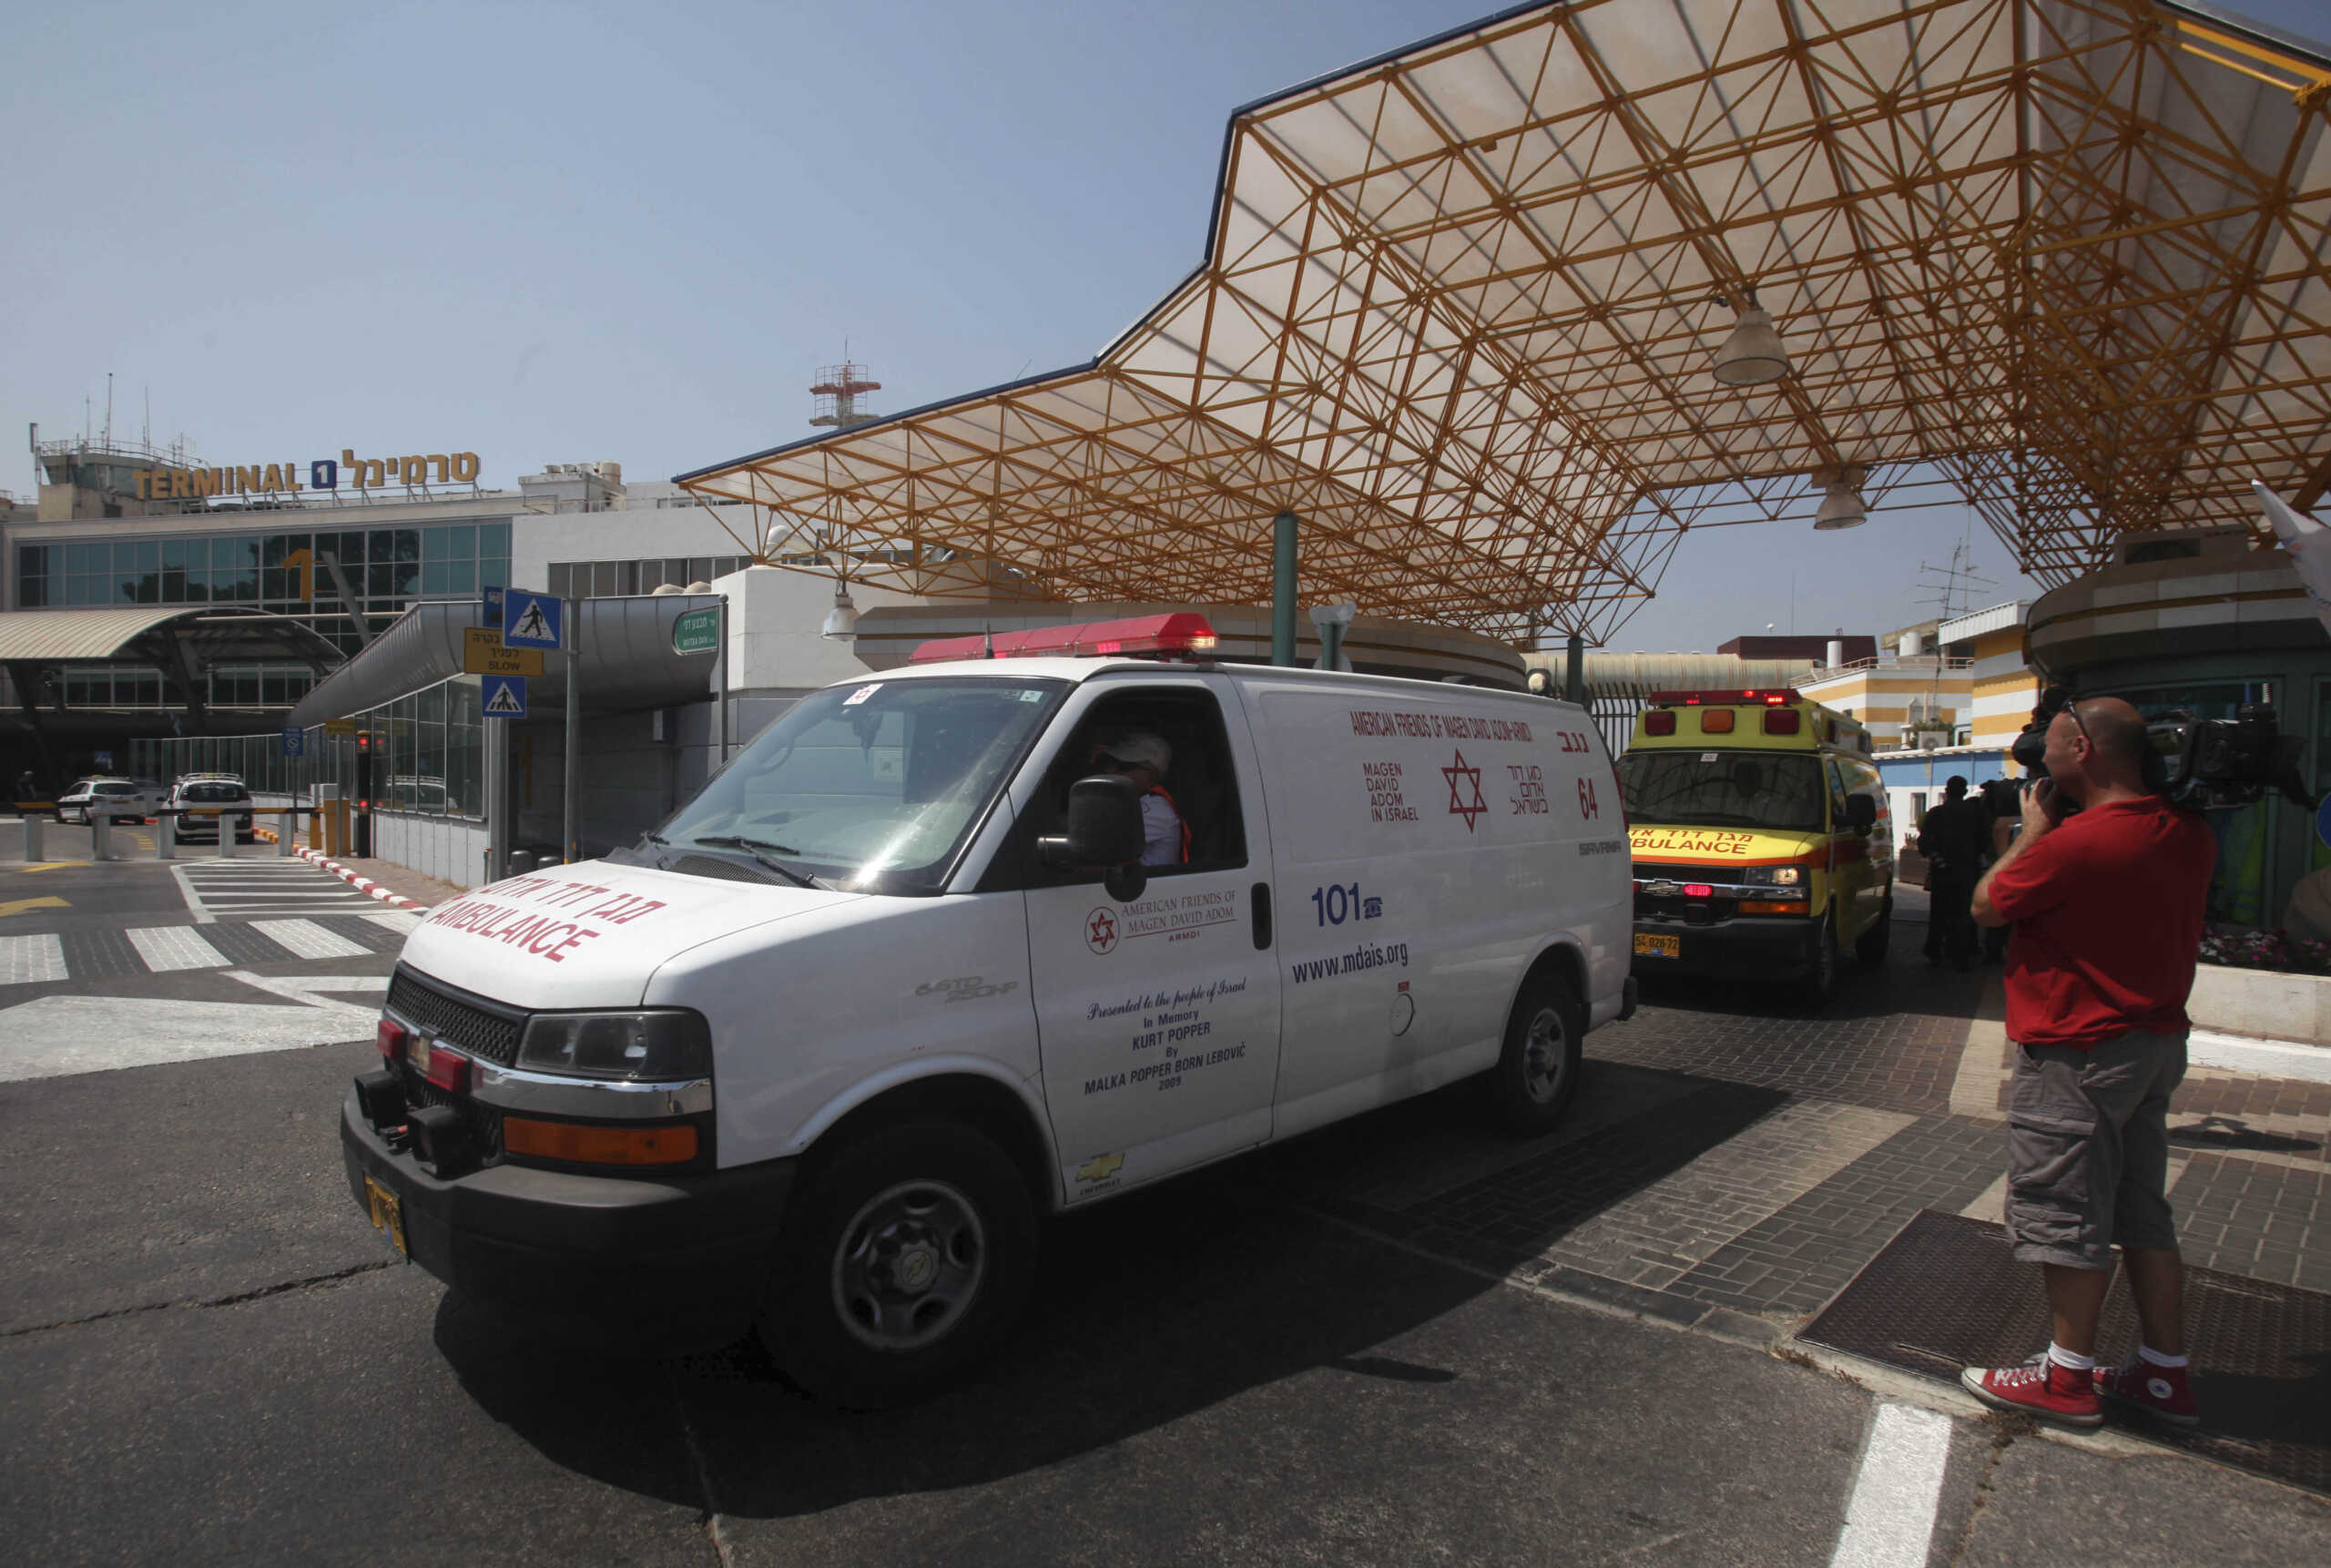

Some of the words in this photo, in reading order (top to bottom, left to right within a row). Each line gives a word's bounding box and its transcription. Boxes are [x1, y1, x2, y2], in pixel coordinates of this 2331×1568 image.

[341, 449, 480, 488] טרמינל
[131, 463, 303, 499] TERMINAL
[488, 661, 520, 671] SLOW
[1350, 710, 1397, 737] AMERICAN
[1394, 713, 1432, 738] FRIENDS
[1430, 715, 1443, 738] OF
[1441, 715, 1472, 739] MAGEN
[1468, 717, 1491, 740] DAVID
[1556, 731, 1590, 754] נגב
[1363, 762, 1402, 777] MAGEN
[1507, 765, 1523, 780] דוד
[1527, 765, 1542, 780] מגן
[1366, 778, 1400, 791] DAVID
[1520, 782, 1545, 798] אדום
[1370, 792, 1404, 807] ADOM
[1577, 777, 1599, 820] 64
[1371, 807, 1383, 822] IN
[1385, 807, 1420, 822] ISRAEL
[1631, 829, 1654, 837] אד
[1667, 830, 1705, 839] דוד
[1716, 832, 1754, 843] מגן
[1630, 838, 1749, 854] BULANCE
[535, 881, 612, 909] דוד
[1121, 897, 1177, 918] AMERICAN
[1182, 892, 1223, 910] FRIENDS
[1225, 890, 1237, 902] OF
[1312, 882, 1360, 927] 101
[575, 893, 668, 926] מגן
[1128, 916, 1166, 934] MAGEN
[1171, 911, 1203, 927] DAVID
[1206, 906, 1235, 921] ADOM
[425, 900, 602, 962] AMBULANCE
[1292, 942, 1409, 984] www.mdais.org
[1086, 994, 1143, 1021] Presented
[1143, 993, 1154, 1011] to
[1155, 990, 1171, 1008] the
[1173, 984, 1205, 1011] people
[1206, 981, 1217, 1003] of
[1216, 975, 1247, 996] Israel
[1143, 1017, 1154, 1029] In
[1157, 1009, 1200, 1026] Memory
[1132, 1031, 1166, 1052] KURT
[1167, 1021, 1212, 1044] POPPER
[1165, 1046, 1179, 1059] By
[1084, 1072, 1127, 1095] MALKA
[1129, 1062, 1173, 1084] POPPER
[1174, 1054, 1205, 1074] BORN
[1157, 1075, 1183, 1092] 2009
